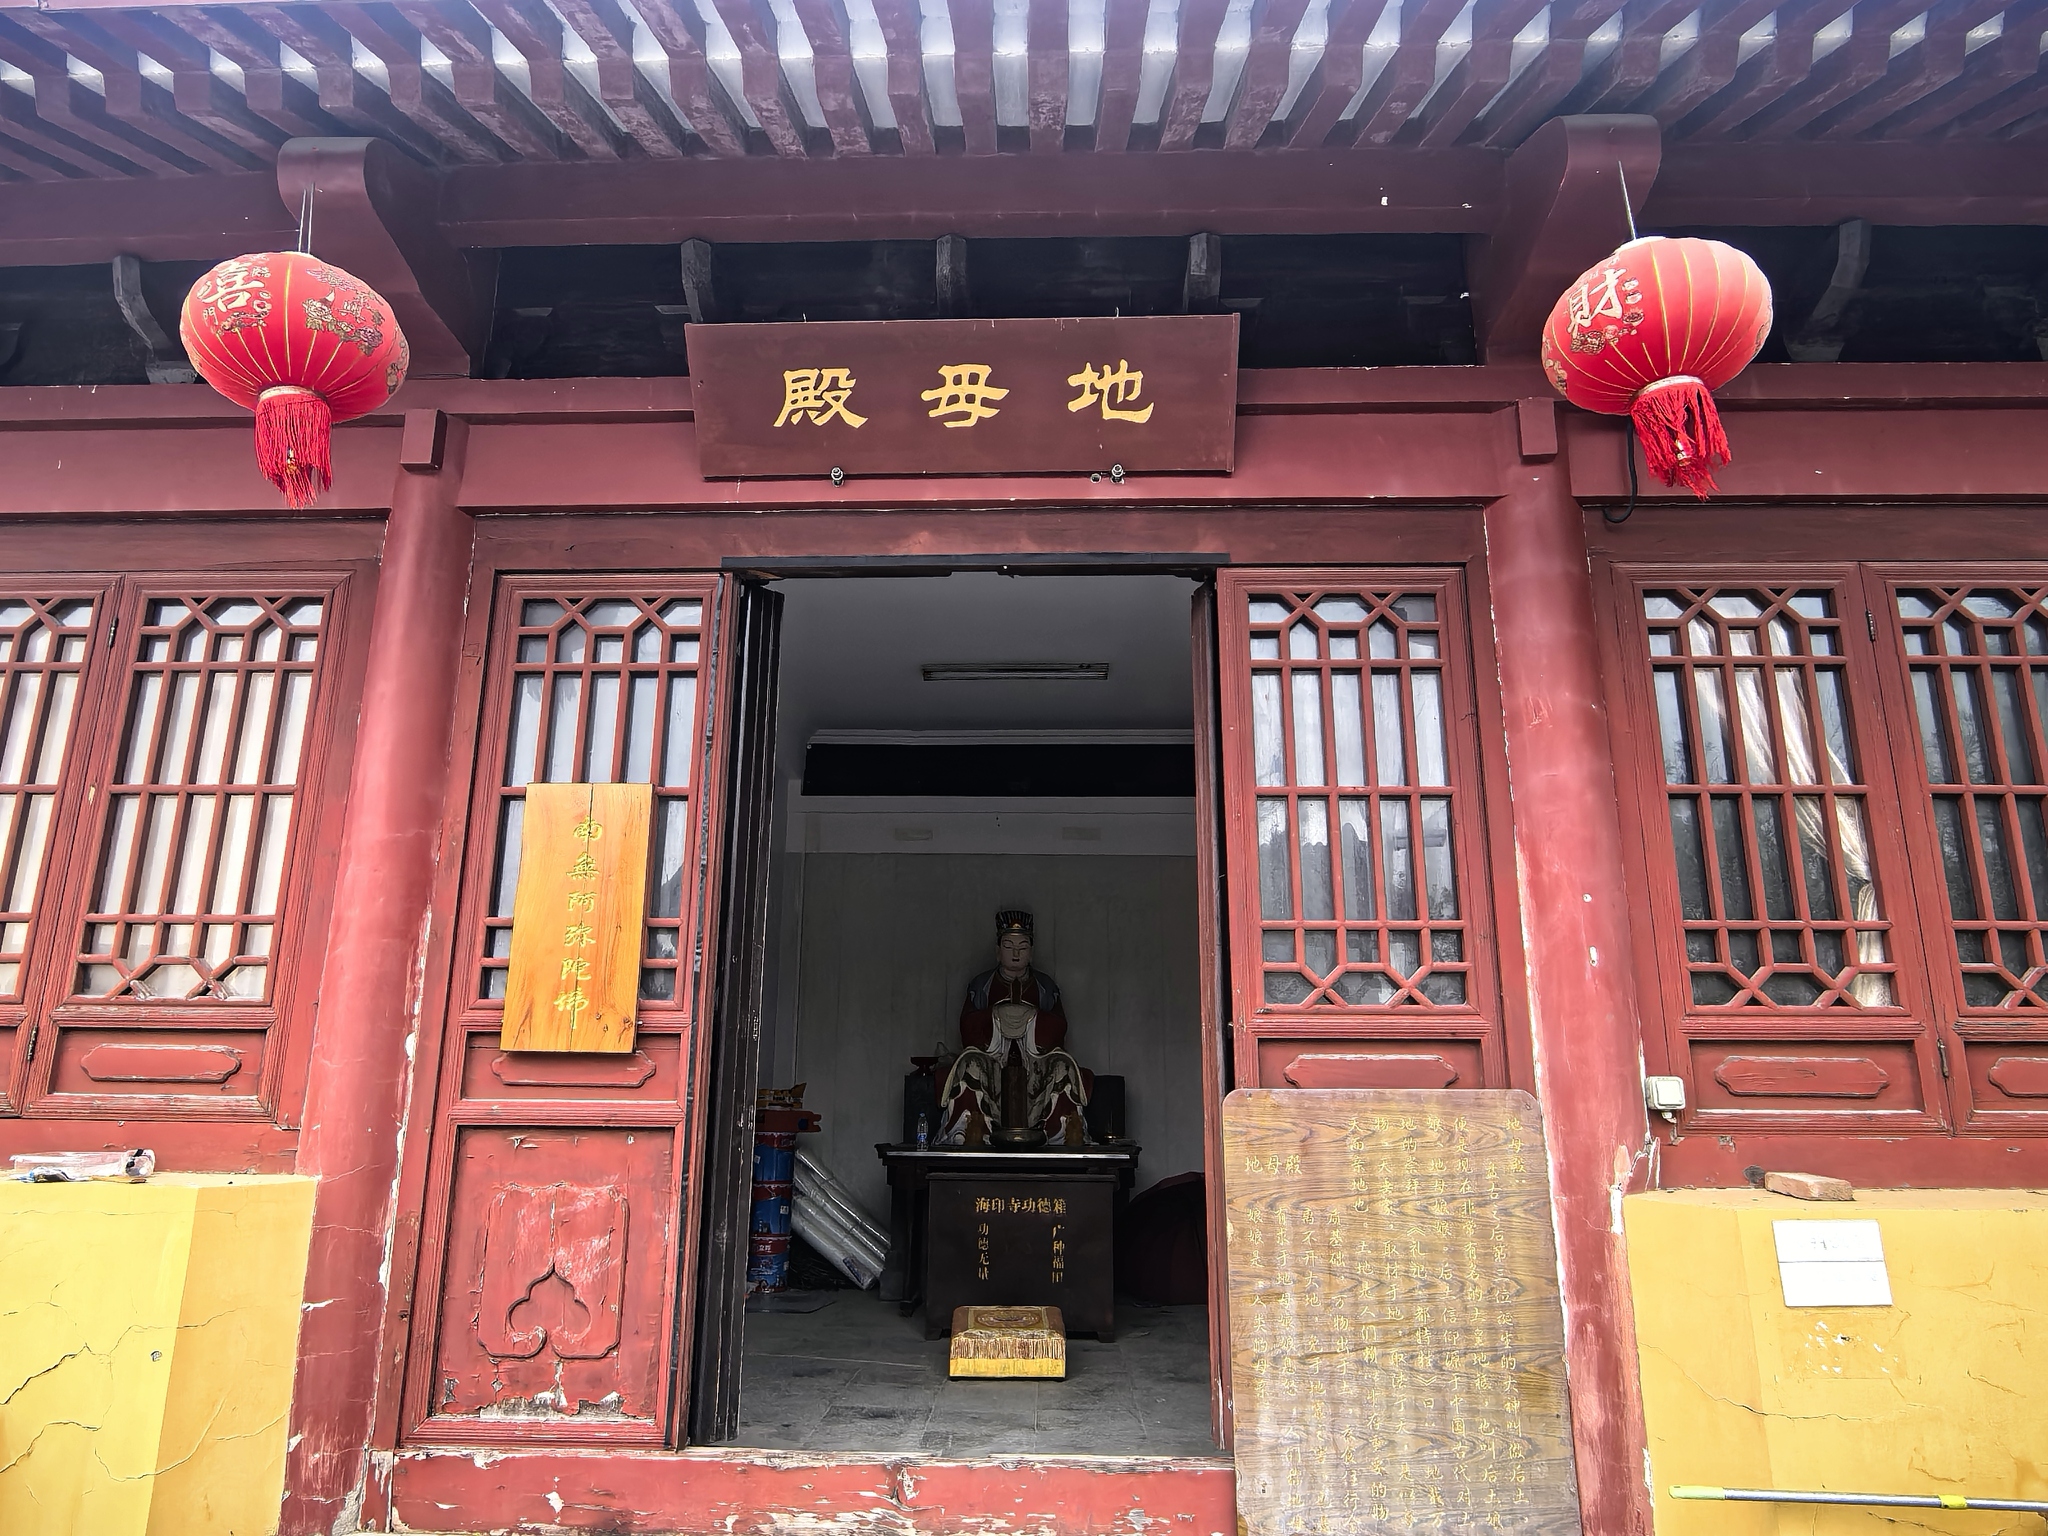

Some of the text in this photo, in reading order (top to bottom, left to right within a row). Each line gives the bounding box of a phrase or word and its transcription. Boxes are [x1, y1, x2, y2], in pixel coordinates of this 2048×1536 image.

[1567, 267, 1627, 338] 財
[773, 358, 1154, 429] 地母殿
[1244, 1156, 1302, 1175] 地母殿
[975, 1197, 1067, 1216] 海印寺功德箱
